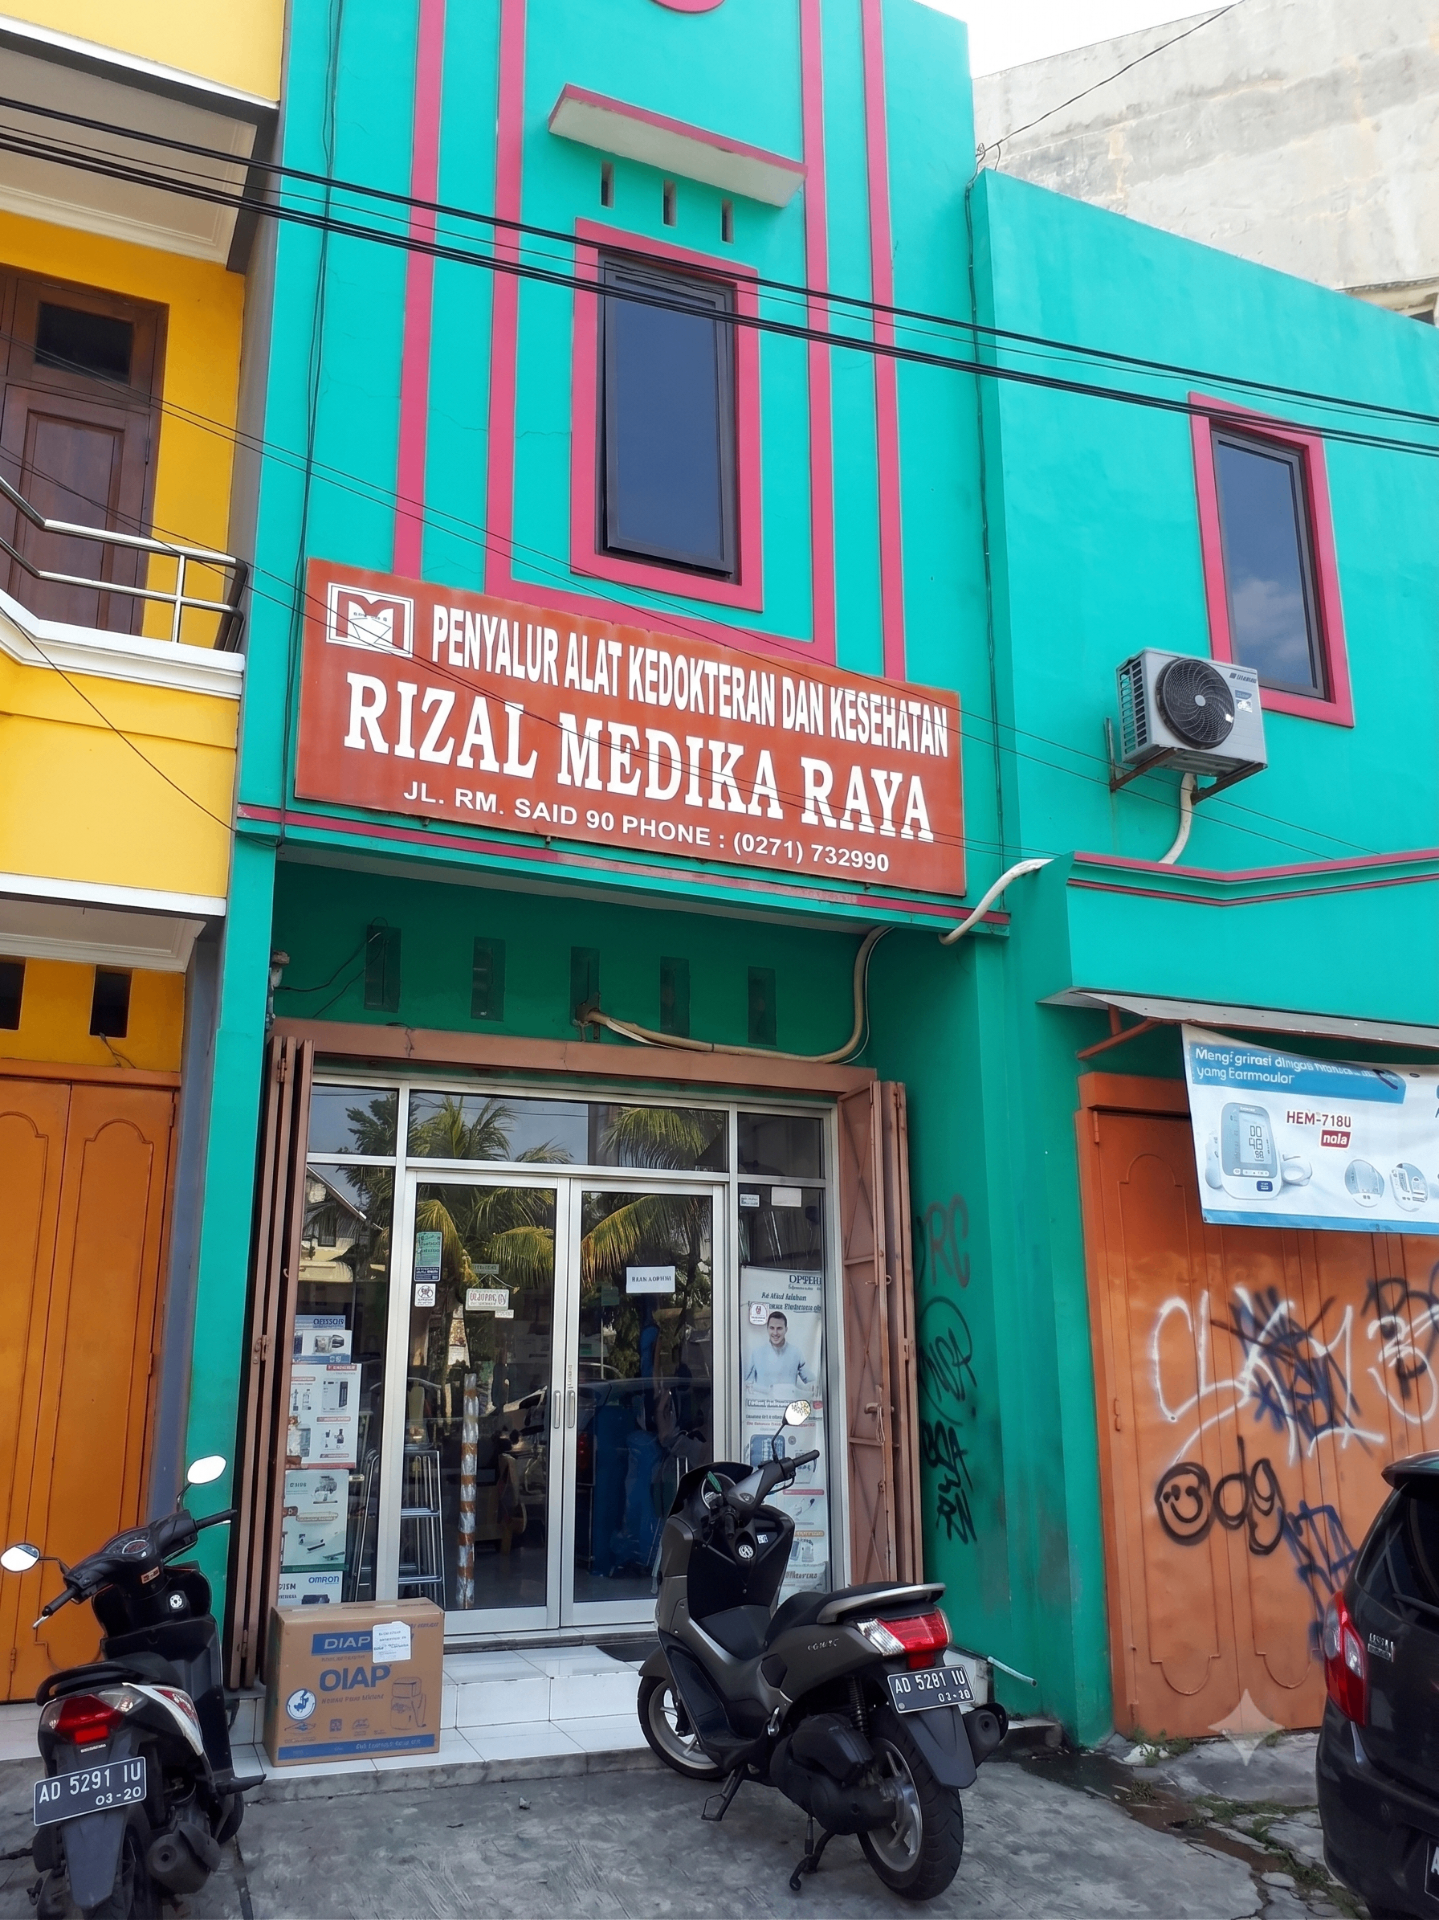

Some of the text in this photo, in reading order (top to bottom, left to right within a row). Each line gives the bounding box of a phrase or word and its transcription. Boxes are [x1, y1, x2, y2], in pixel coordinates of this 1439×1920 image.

[431, 603, 949, 758] PENYALUR ALAT KEDOKTERAN DAN KESEHATAN
[343, 671, 935, 843] RIZAL MEDIKA RAYA
[403, 780, 445, 805] JL.
[454, 787, 505, 815] RM.
[514, 797, 578, 826] SAID
[585, 809, 616, 832] 90
[621, 814, 712, 848] PHONE
[733, 831, 804, 865] (0271)
[810, 843, 890, 873] 732990
[324, 1636, 371, 1650] DIAP
[896, 1677, 912, 1695] AD
[39, 1761, 142, 1803] AD 5291 IU
